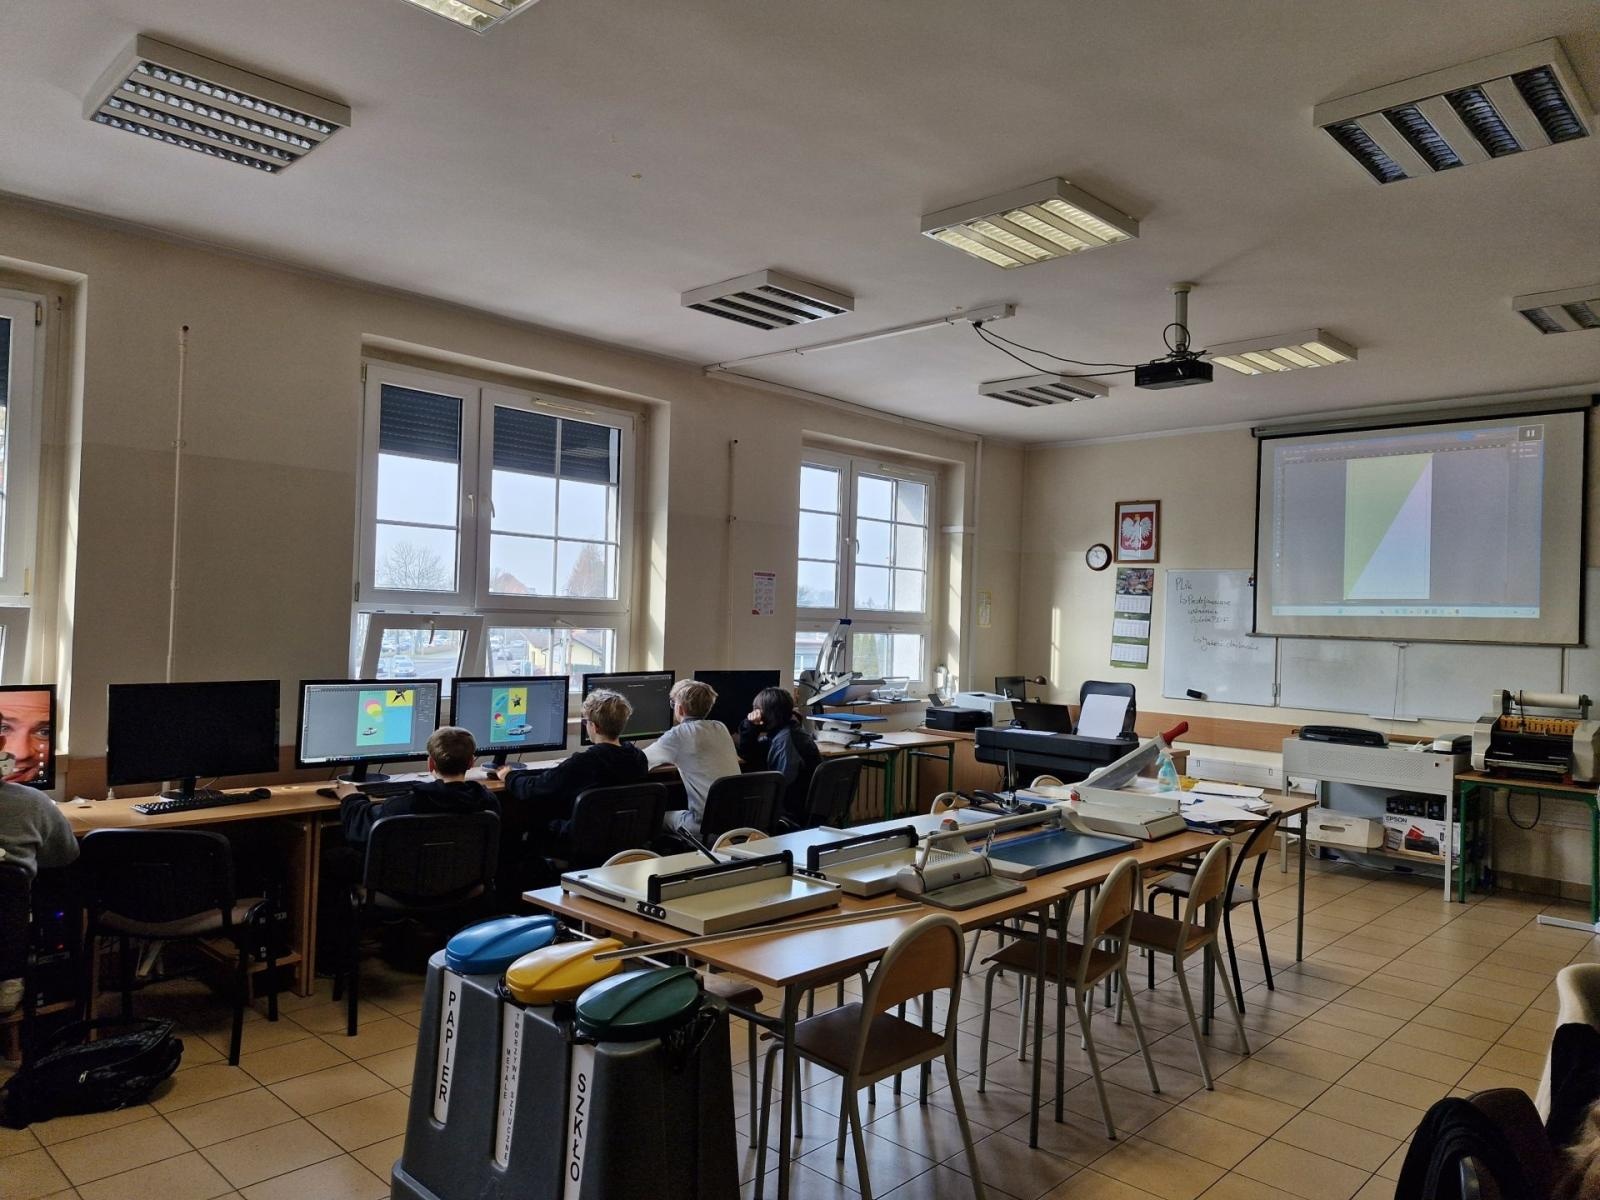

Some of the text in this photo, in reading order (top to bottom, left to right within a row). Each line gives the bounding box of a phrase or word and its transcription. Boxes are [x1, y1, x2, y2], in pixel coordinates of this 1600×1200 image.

[1385, 815, 1408, 824] EPSON
[438, 990, 457, 1103] PAPIER
[570, 1073, 587, 1182] SZKŁO
